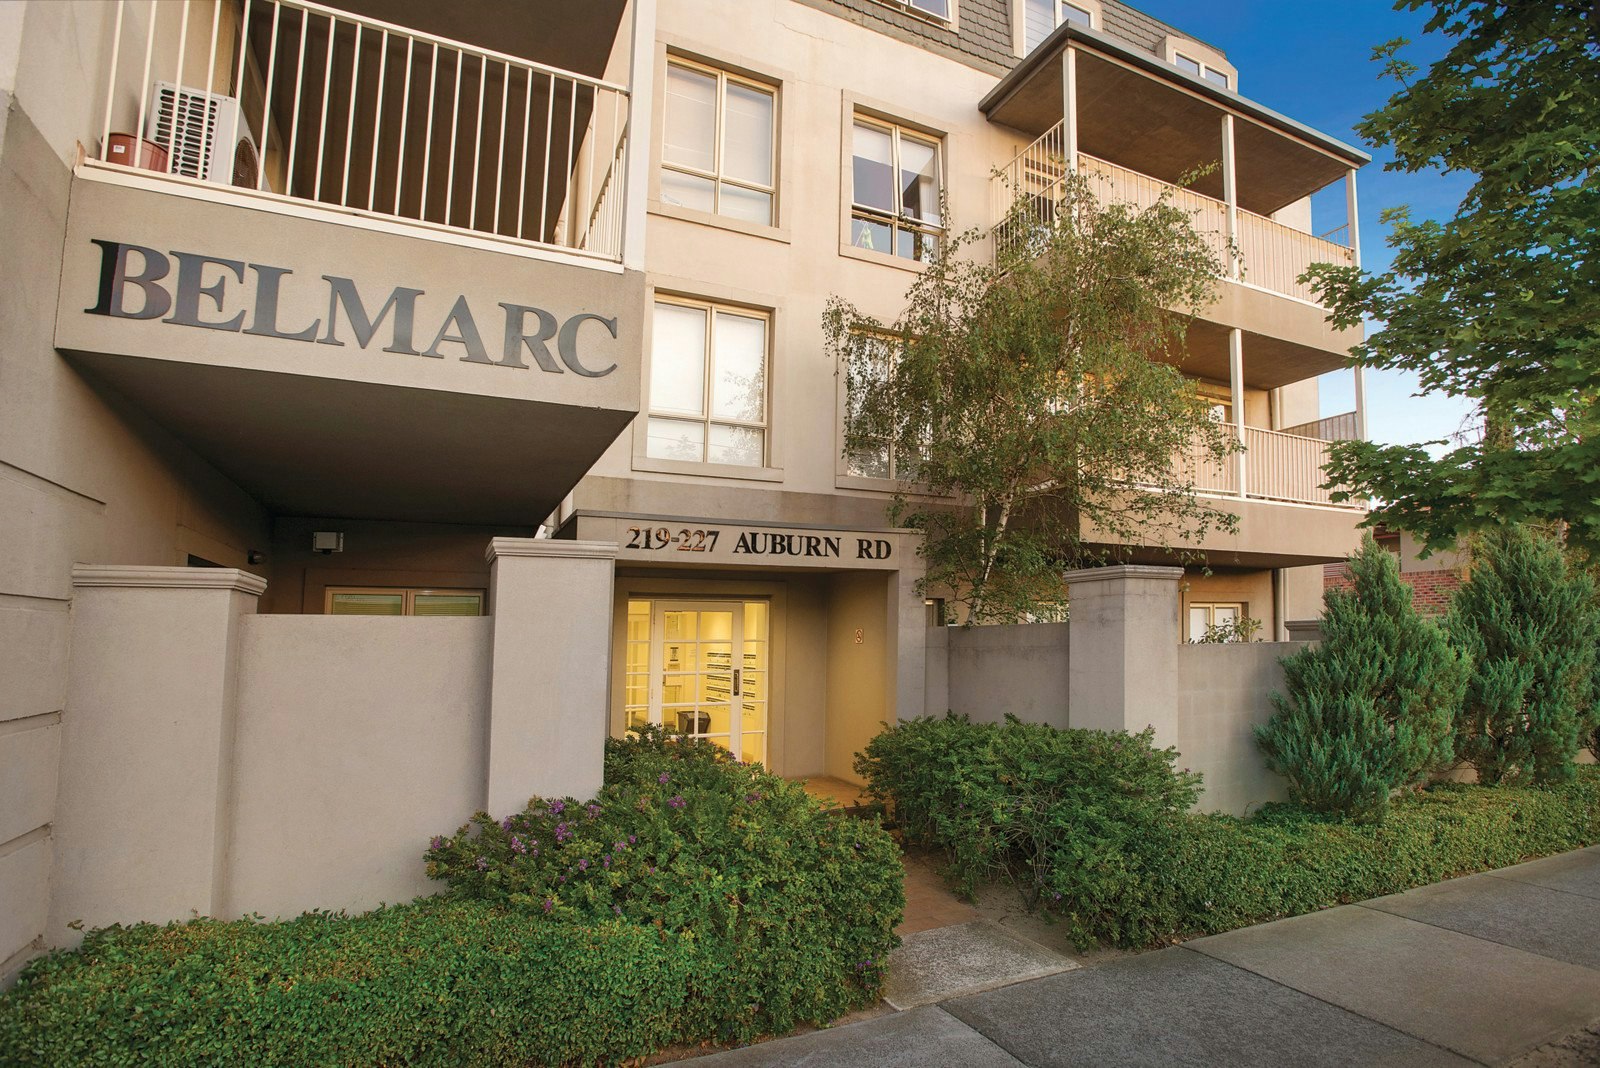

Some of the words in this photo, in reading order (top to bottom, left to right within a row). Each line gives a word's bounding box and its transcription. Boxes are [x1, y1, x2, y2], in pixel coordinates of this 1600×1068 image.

[84, 239, 617, 377] BELMARC
[625, 526, 720, 553] 219-227
[733, 532, 842, 558] AUBURN
[856, 539, 892, 560] RD
